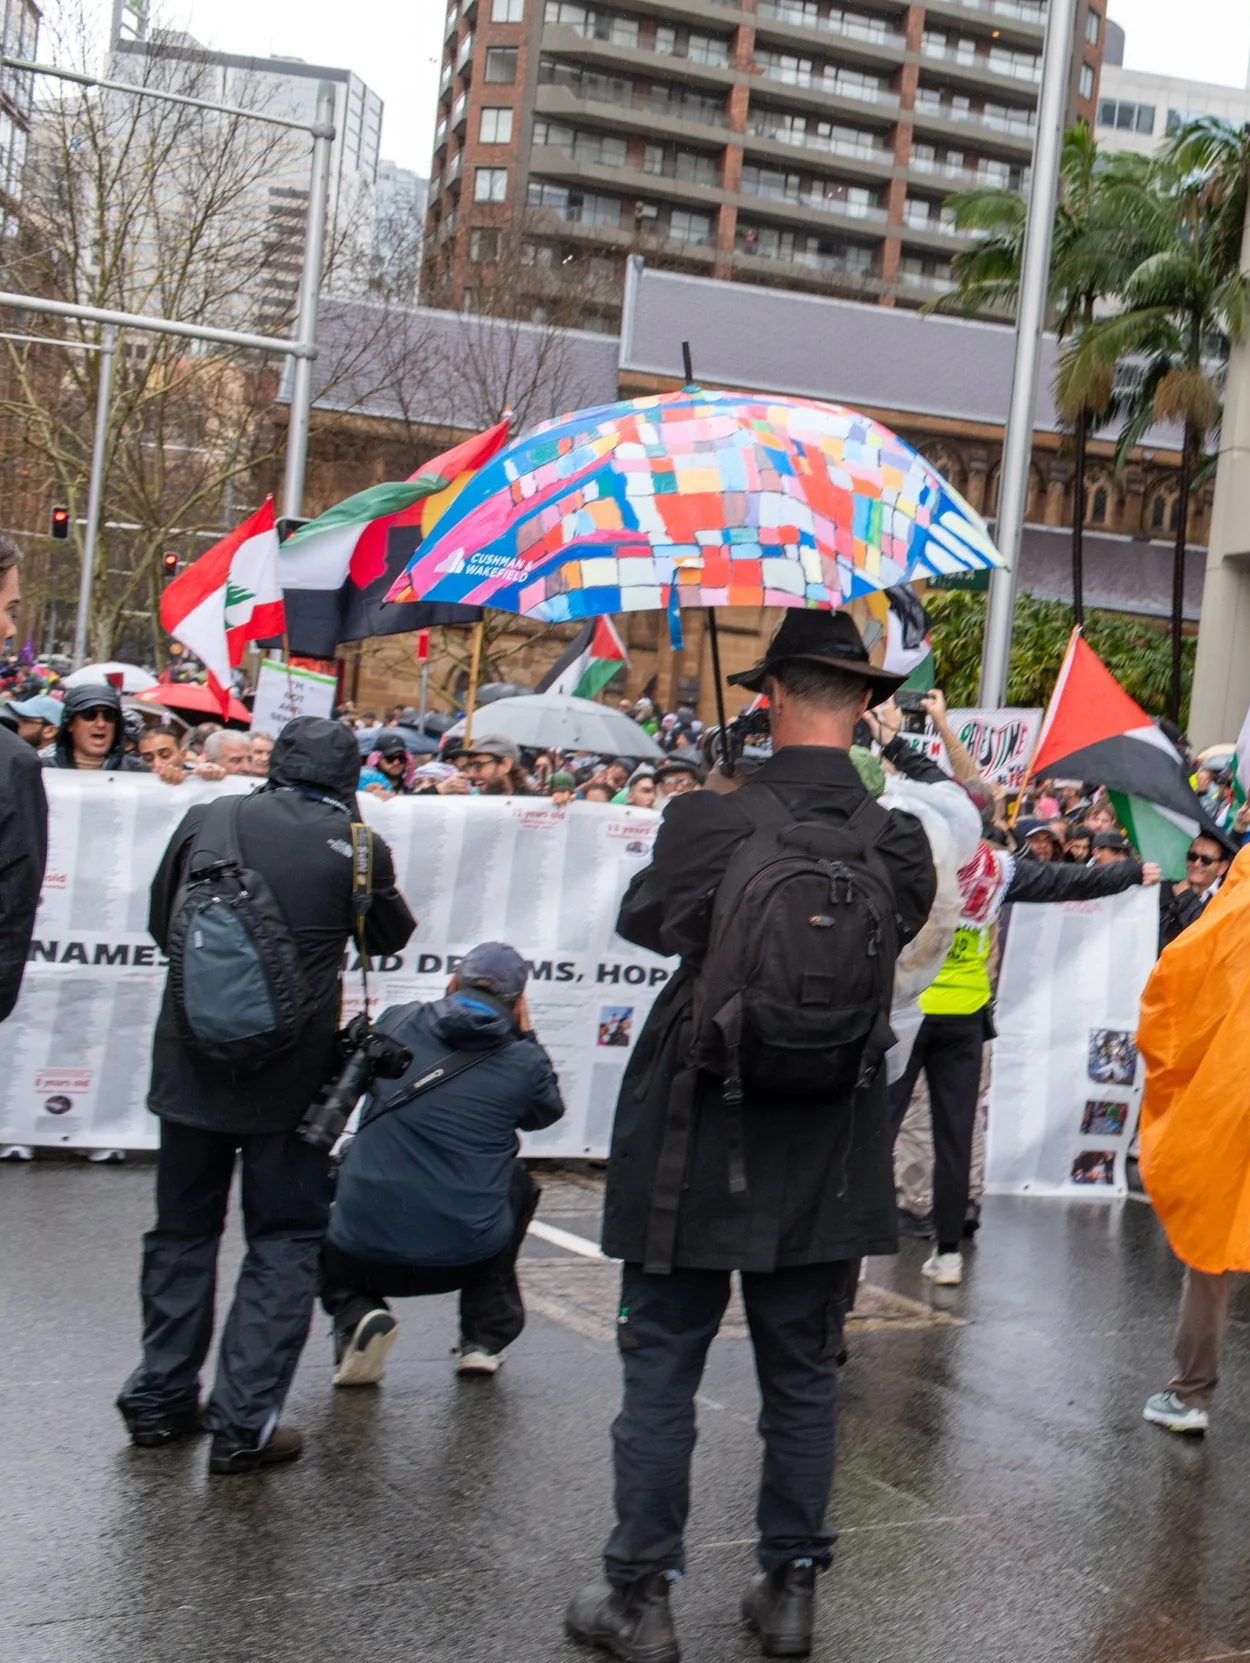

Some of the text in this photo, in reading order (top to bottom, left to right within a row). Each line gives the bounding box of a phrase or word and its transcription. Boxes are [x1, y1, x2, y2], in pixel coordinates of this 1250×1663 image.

[469, 552, 524, 570] CUSHMAN
[465, 564, 529, 583] WAKEFIELD
[524, 810, 548, 820] years
[551, 809, 566, 820] old
[623, 826, 650, 836] years
